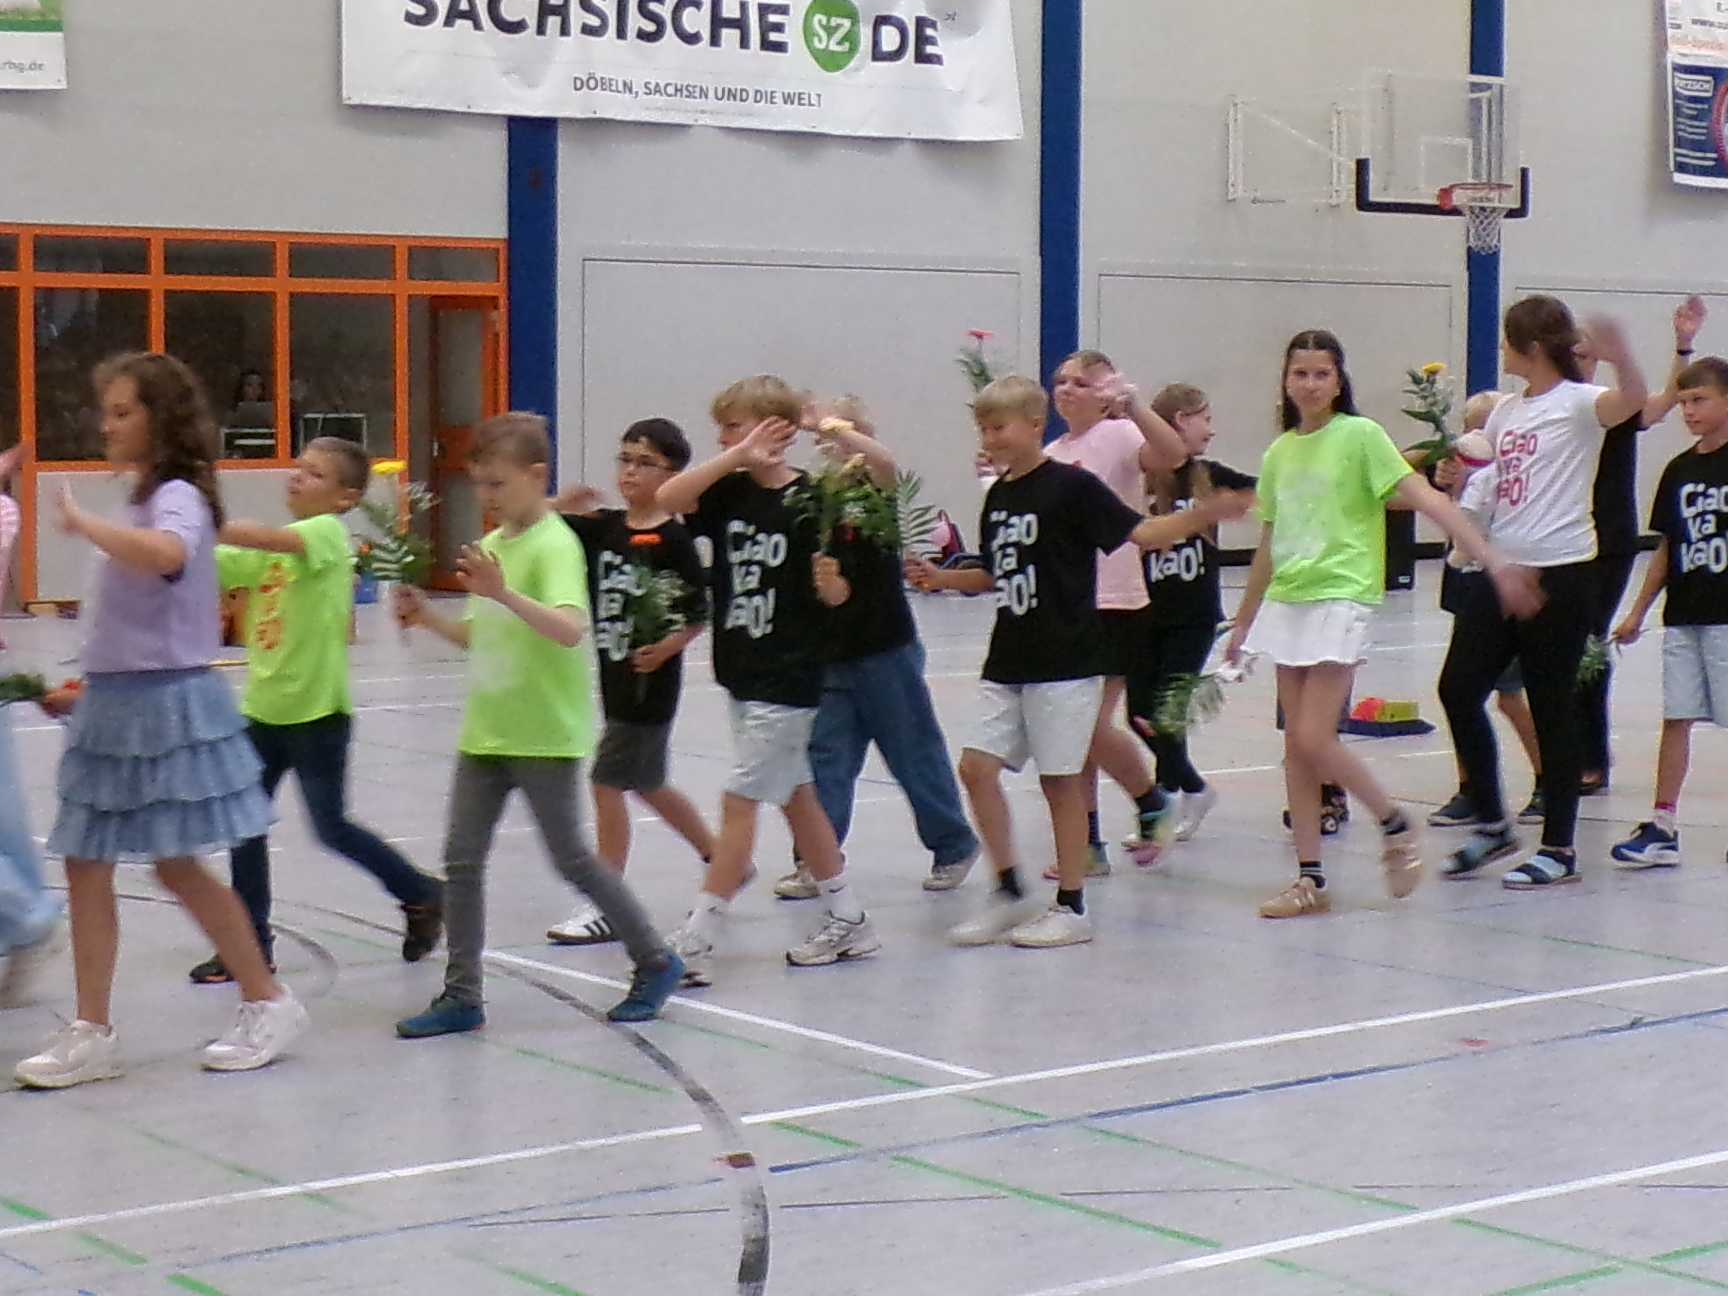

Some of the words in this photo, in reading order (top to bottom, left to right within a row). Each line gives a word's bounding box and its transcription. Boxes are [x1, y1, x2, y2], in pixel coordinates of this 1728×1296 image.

[812, 13, 852, 52] SZ
[870, 13, 945, 67] DE
[572, 72, 639, 100] DÖBELN,
[643, 80, 709, 101] SACHSEN
[714, 84, 750, 104] UND
[753, 86, 777, 105] DIE
[781, 90, 822, 108] WELT
[1499, 431, 1537, 456] Ciao
